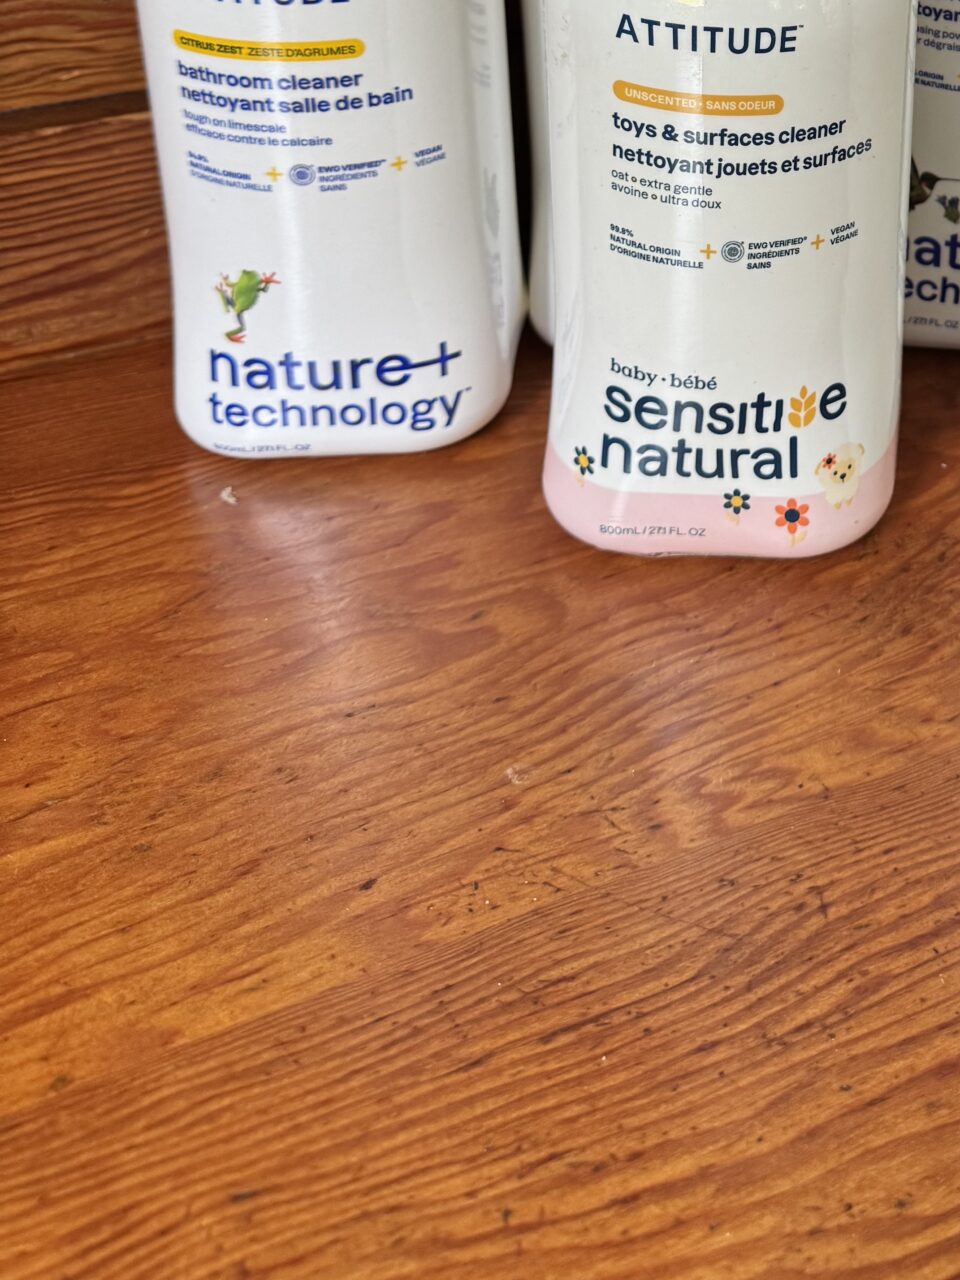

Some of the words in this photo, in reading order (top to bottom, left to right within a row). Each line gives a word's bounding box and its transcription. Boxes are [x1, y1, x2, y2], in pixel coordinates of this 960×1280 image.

[615, 13, 798, 54] ATTITUDE
[180, 35, 215, 52] CITRUS
[217, 43, 243, 55] ZEST
[248, 46, 285, 57] ZESTE
[286, 45, 356, 57] D'AGRUMES
[178, 60, 272, 90] bathroom
[277, 72, 363, 91] cleaner
[181, 84, 276, 113] nettoyant
[279, 93, 330, 113] salle
[335, 95, 363, 112] de
[368, 86, 413, 108] bain
[625, 87, 697, 108] UNSCENTED
[706, 100, 736, 111] SANS
[738, 100, 776, 111] ODEUR
[183, 108, 211, 125] tough
[213, 119, 226, 127] on
[228, 119, 287, 133] limescale
[612, 112, 657, 138] toys
[662, 124, 679, 141] &
[683, 129, 774, 147] surfaces
[778, 120, 847, 145] cleaner
[185, 123, 225, 140] efficace
[227, 133, 266, 145] contre
[268, 137, 279, 146] le
[281, 137, 332, 146] calcaire
[415, 144, 442, 157] VEGAN
[612, 143, 713, 175] nettoyant
[715, 158, 777, 179] jouets
[781, 155, 799, 172] et
[802, 138, 872, 170] surfaces
[320, 184, 347, 192] SAINS
[611, 169, 629, 183] oat
[640, 173, 671, 192] extra
[674, 182, 713, 197] gentle
[611, 182, 649, 200] avoine
[660, 193, 688, 207] ultra
[691, 196, 721, 209] doux
[610, 224, 634, 237] 99.8%
[830, 229, 859, 245] VÉGANE
[831, 221, 855, 235] VEGAN
[610, 234, 648, 252] NATURAL
[650, 245, 681, 256] ORIGIN
[610, 244, 651, 262] D'ORIGINE
[652, 256, 704, 269] NATURELLE
[748, 248, 800, 260] INGRÉDIENTS
[749, 242, 767, 250] EWG
[747, 261, 771, 269] SAINS
[610, 358, 657, 386] baby
[670, 374, 717, 390] bébé
[209, 390, 464, 431] technology
[600, 433, 798, 480] natural
[600, 524, 640, 535] 800mL
[688, 527, 706, 536] OZ
